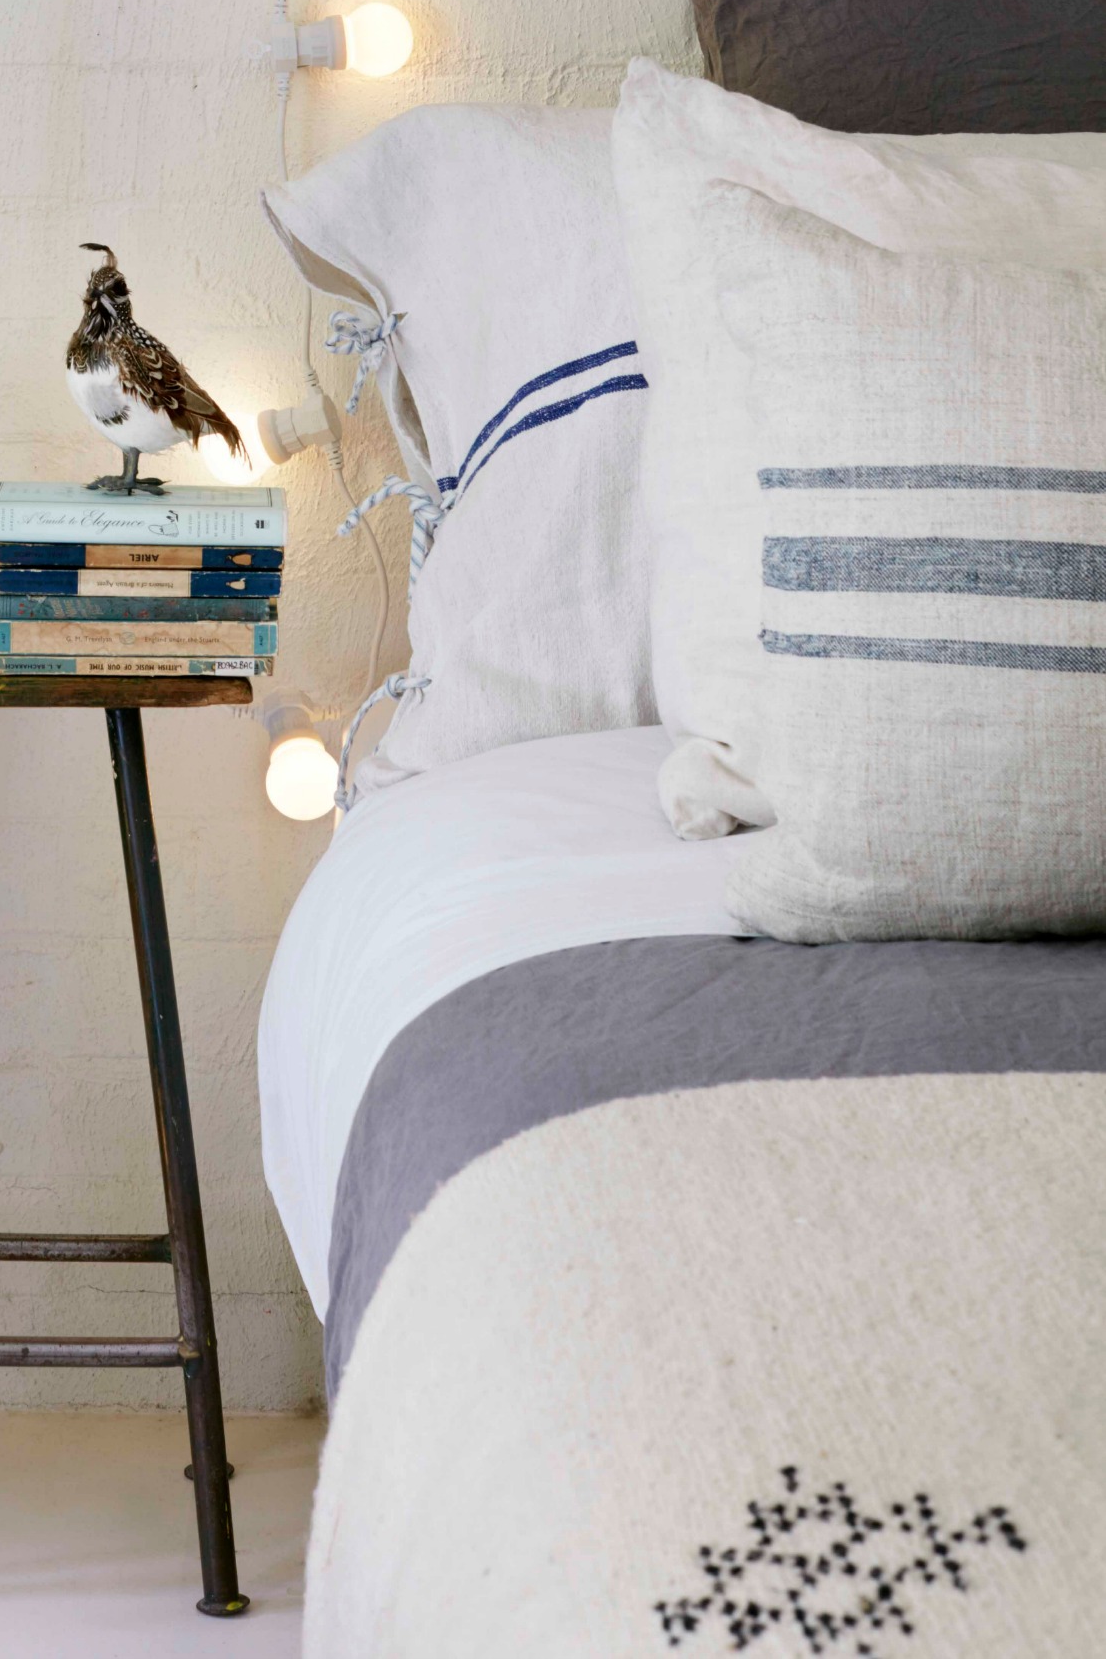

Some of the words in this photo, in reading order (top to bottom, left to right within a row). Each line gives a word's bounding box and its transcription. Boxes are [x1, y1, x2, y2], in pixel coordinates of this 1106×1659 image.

[36, 511, 65, 525] Guide
[68, 516, 80, 525] to
[79, 509, 145, 535] Elegance
[129, 553, 160, 563] ARIEL
[96, 579, 114, 590] Agent
[148, 580, 174, 589] Memoirs
[85, 635, 113, 644] Trevelyan
[144, 636, 169, 645] England
[198, 636, 221, 644] Stuarts
[89, 663, 104, 671] TIME
[107, 664, 121, 672] OUR
[124, 664, 132, 672] OF
[135, 664, 154, 672] MUSIC
